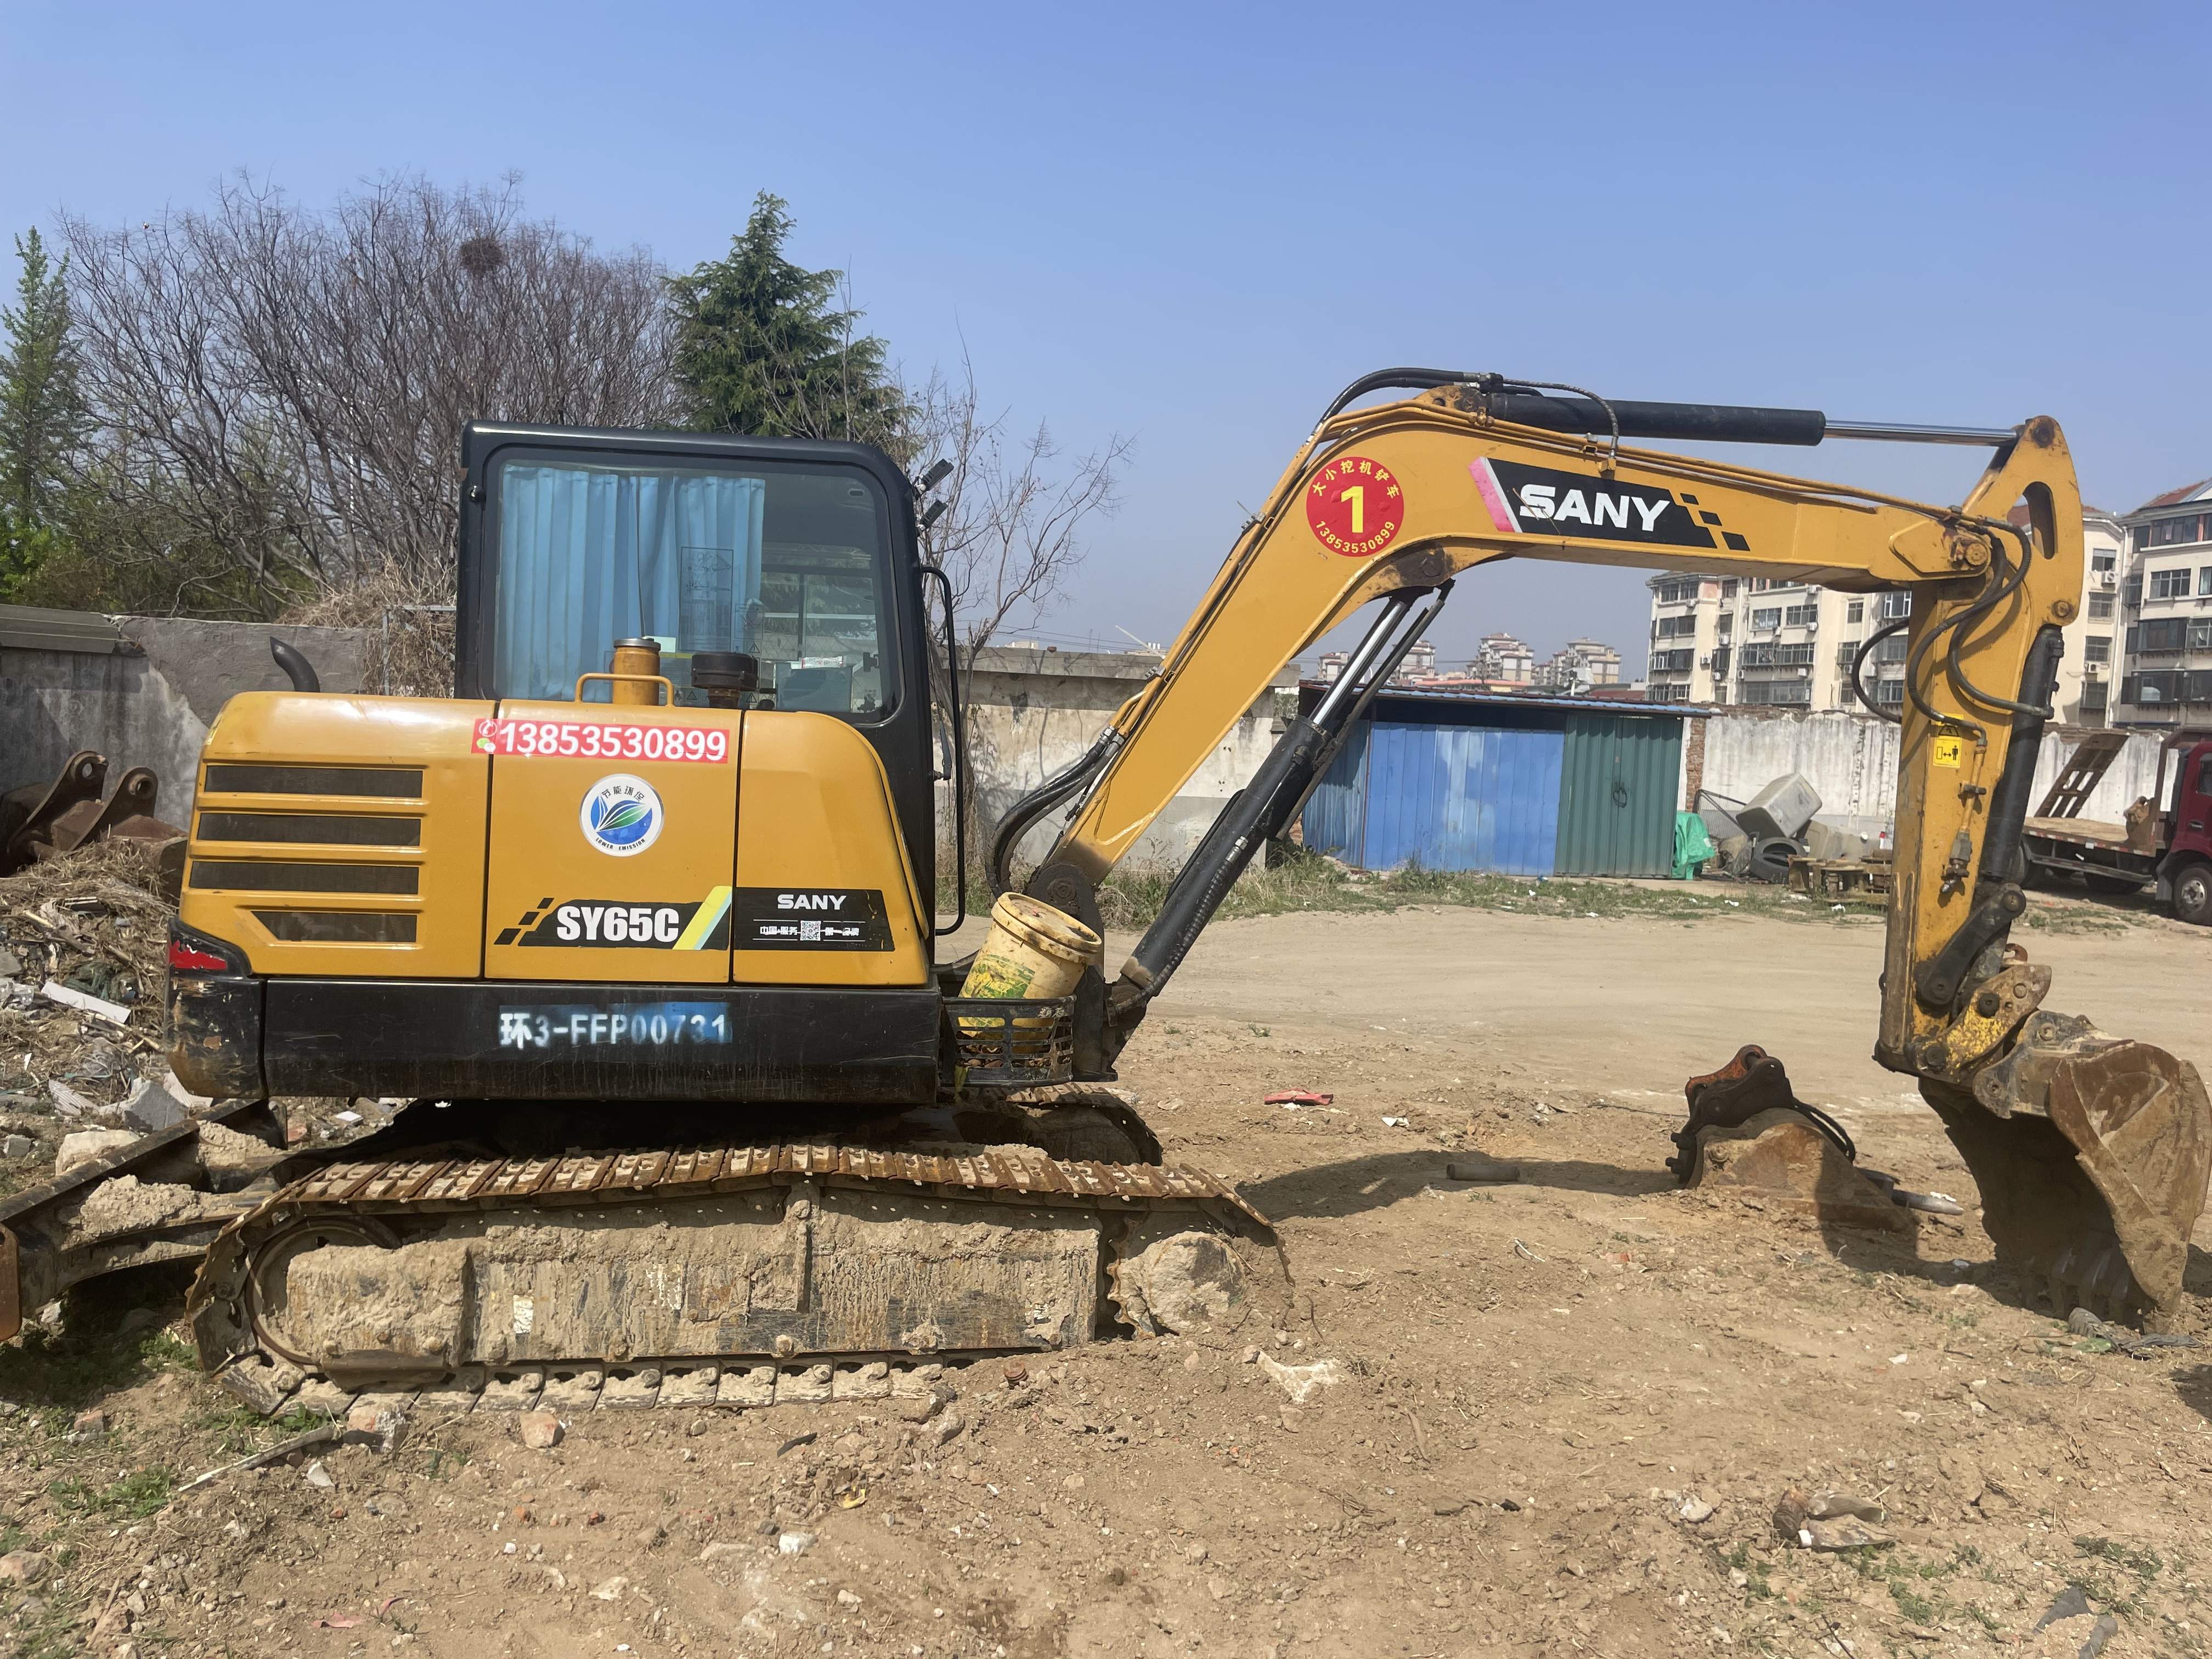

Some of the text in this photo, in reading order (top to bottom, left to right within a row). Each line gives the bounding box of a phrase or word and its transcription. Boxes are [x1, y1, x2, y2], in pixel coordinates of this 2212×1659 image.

[1312, 460, 1400, 499] 大小挖机铲车
[1341, 486, 1363, 533] 1
[1519, 484, 1671, 532] SANY
[1316, 521, 1395, 554] 13853530899
[500, 722, 726, 761] 13853530899
[601, 785, 645, 803] 节能环保
[596, 837, 646, 851] LOWER EMISSION
[777, 894, 847, 911] SANY
[556, 906, 680, 943] SY65C
